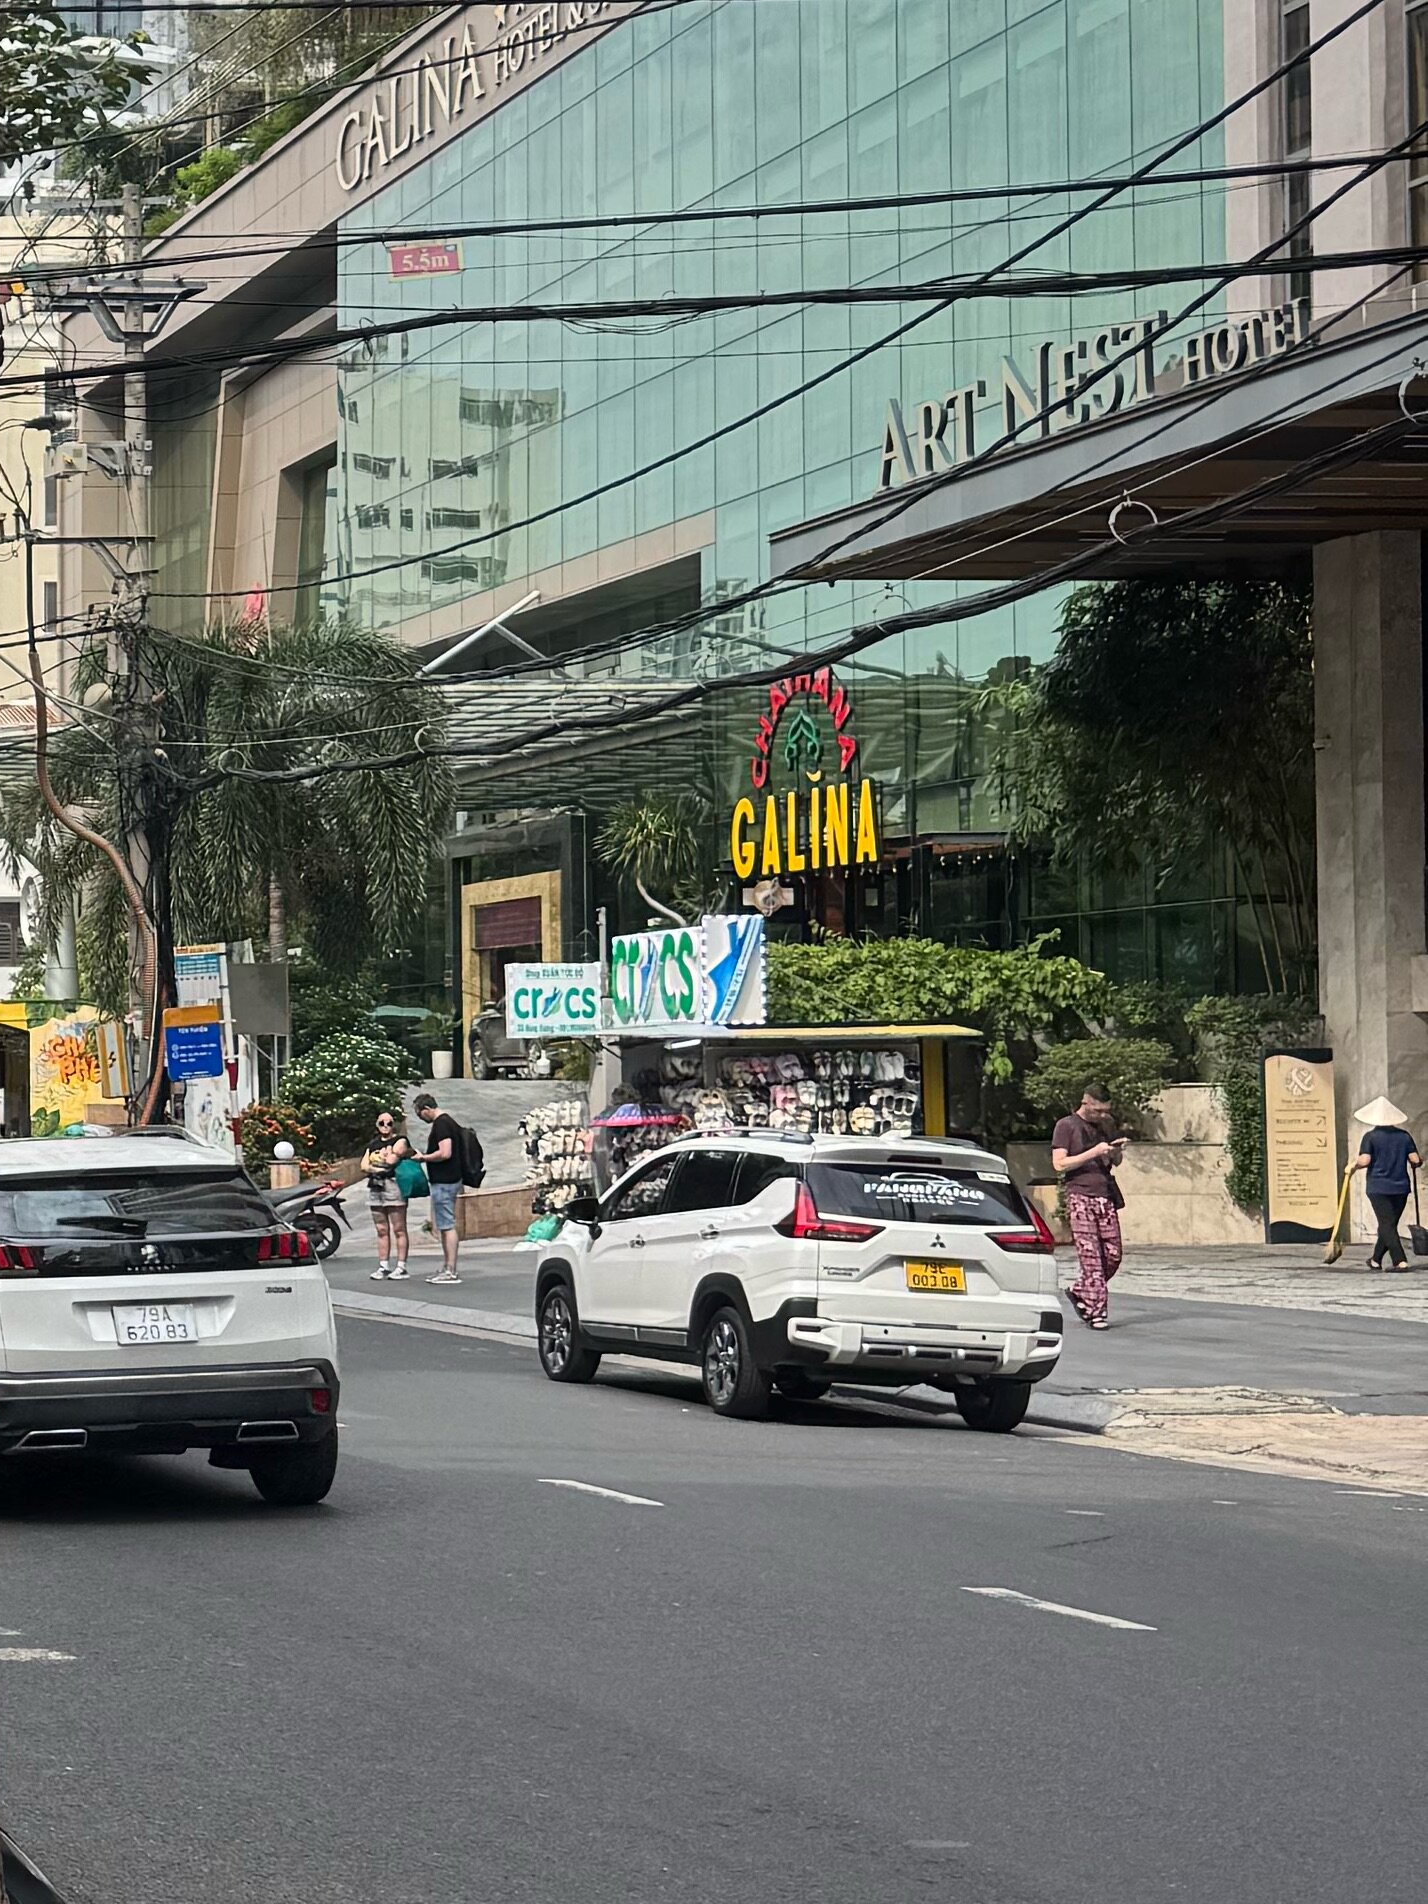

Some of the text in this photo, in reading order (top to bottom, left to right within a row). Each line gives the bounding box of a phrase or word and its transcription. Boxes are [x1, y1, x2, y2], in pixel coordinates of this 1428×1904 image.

[334, 22, 486, 191] GALINA
[493, 10, 564, 86] HOTEL
[401, 250, 450, 272] 5.5m
[879, 297, 1312, 491] ART NEST HOTEL
[612, 930, 695, 1024] crcs
[514, 987, 596, 1019] crcs
[912, 1274, 958, 1288] 003.08
[136, 1306, 173, 1323] 79A
